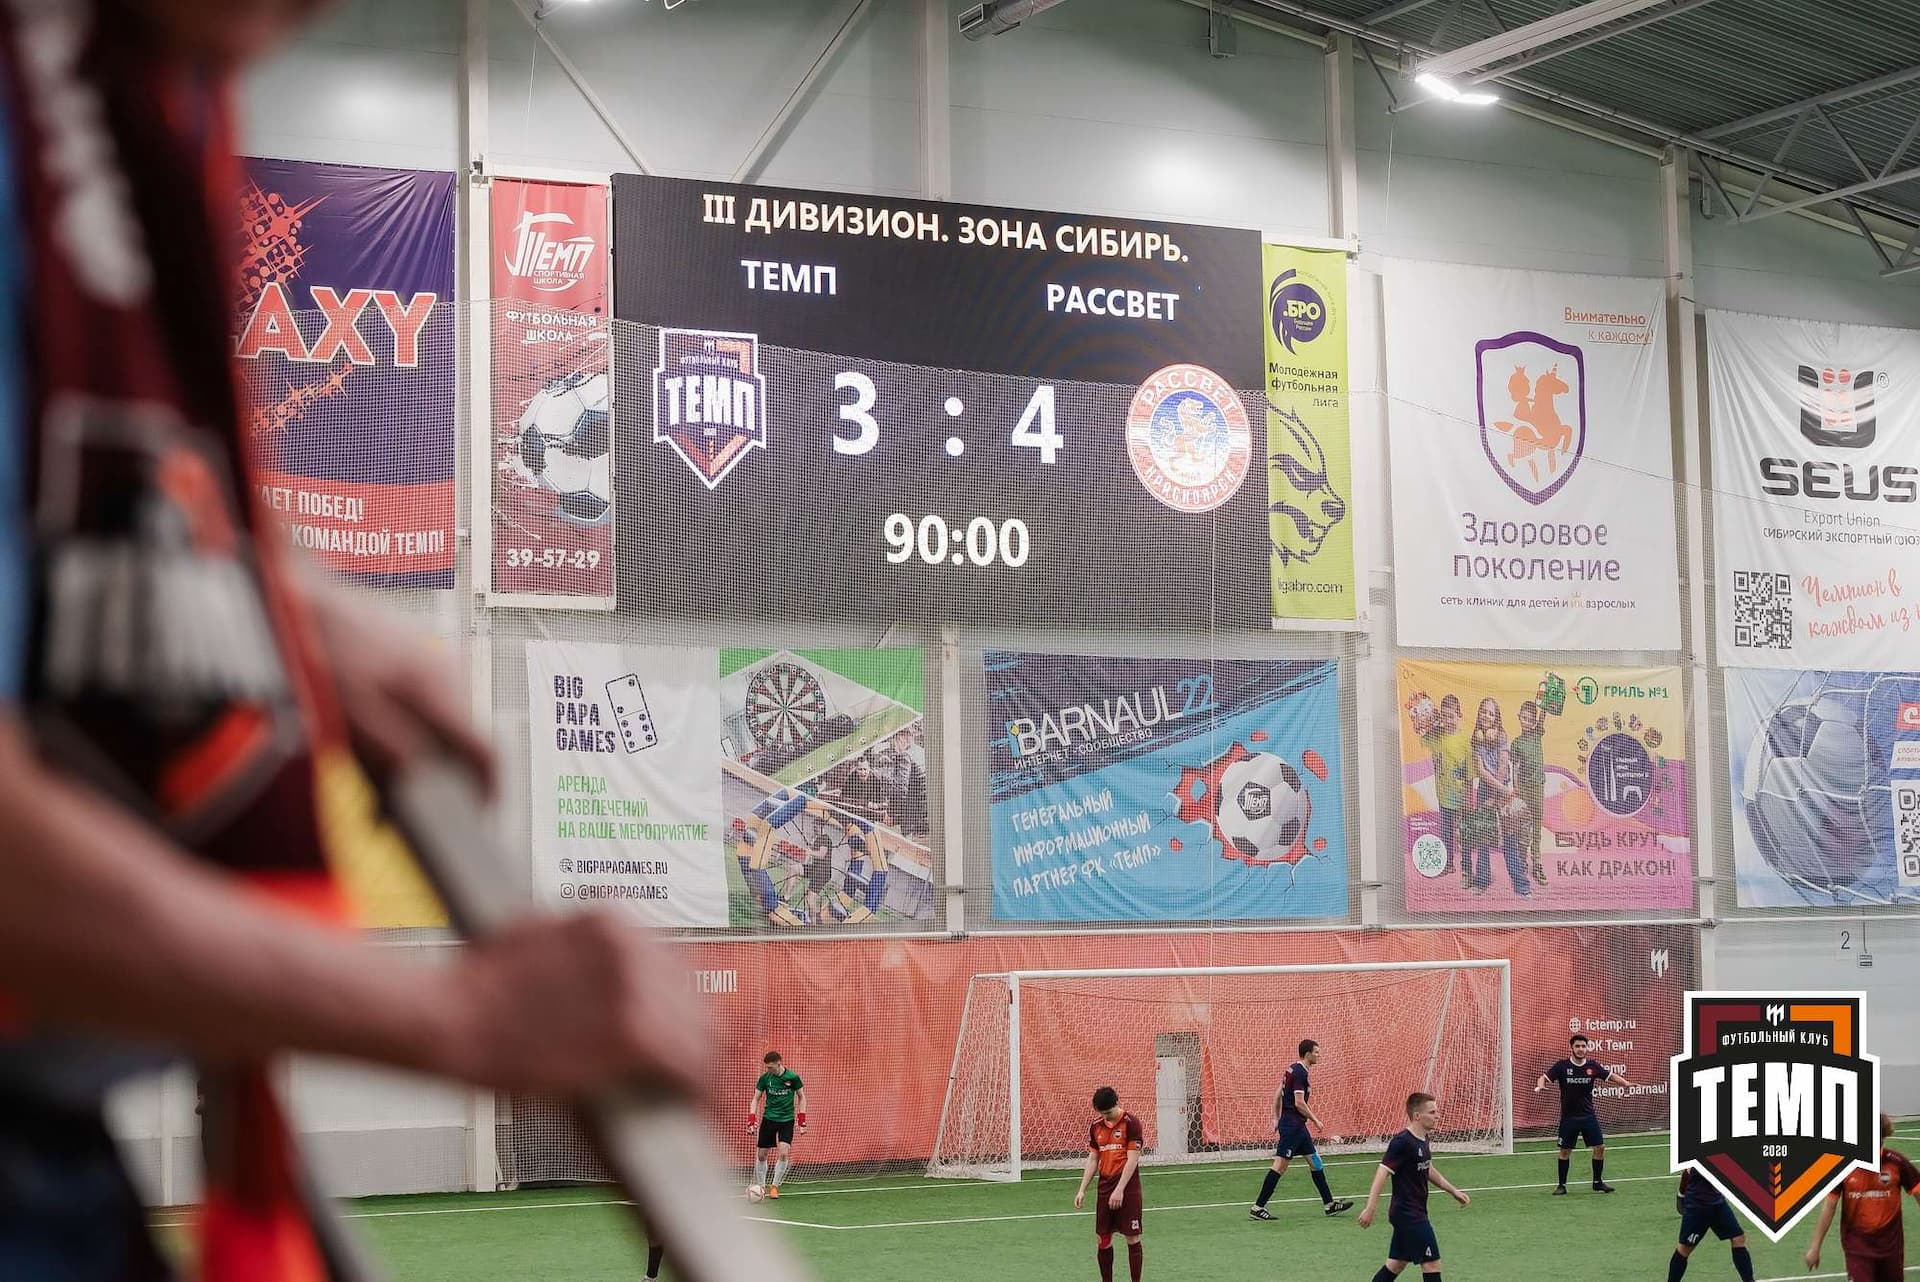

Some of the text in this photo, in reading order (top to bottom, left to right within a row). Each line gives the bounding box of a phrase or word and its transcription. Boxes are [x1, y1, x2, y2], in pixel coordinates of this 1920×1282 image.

[745, 199, 949, 242] ДИВИЗИОН.
[958, 217, 1047, 251] ЗОНА
[1055, 225, 1189, 264] СИБИРЬ.
[533, 270, 585, 280] СПОРТИВНАЯ
[741, 259, 838, 295] ТЕМП
[1046, 283, 1181, 322] РАССВЕТ
[231, 281, 438, 368] AXY
[505, 311, 598, 327] ФУТБОЛЬНАЯ
[1564, 306, 1647, 325] Внимательно
[526, 328, 574, 342] ШКОЛА
[1268, 362, 1339, 379] Молодёжная
[1141, 370, 1239, 411] РАССВЕТ
[1271, 377, 1339, 394] футбольная
[664, 374, 756, 432] ТЕМП
[1312, 398, 1339, 409] лига
[832, 371, 1065, 465] 3 : 4
[1759, 456, 1919, 503] SEUS
[297, 491, 365, 522] ПОБЕД!
[1804, 510, 1881, 528] Export Union
[291, 525, 391, 557] КОМАНДОЙ
[395, 529, 445, 555] ТЕМП!
[884, 512, 1031, 568] 90:00
[1462, 512, 1608, 549] Здоровое
[1763, 527, 1823, 542] СИБИРСКИЙ
[1825, 532, 1893, 545] ЭКСПОРТНЫЙ
[506, 548, 601, 569] 39-57-29
[1453, 554, 1622, 582] поколение
[1801, 575, 1887, 608] Чемпион
[1440, 595, 1463, 606] сеть
[1466, 596, 1504, 607] клиник
[1506, 599, 1526, 609] для
[1528, 596, 1559, 608] детей
[1562, 600, 1569, 608] и
[1585, 600, 1636, 611] взрослых
[1807, 605, 1887, 639] каждом
[1890, 607, 1913, 632] из
[553, 675, 583, 699] BIG
[1603, 686, 1645, 699] ГРИЛЬ
[1648, 687, 1670, 699] №1
[556, 702, 600, 726] PAPA
[556, 728, 616, 753] GAMES
[1014, 747, 1070, 770] ИНТЕРНЕТ
[1078, 727, 1154, 755] СООБЩЕСТВО
[558, 775, 608, 796] АРЕНДА
[558, 797, 649, 818] РАЗВЛЕЧЕНИЙ
[1012, 787, 1114, 833] ГЕНЕРАЛЬНЫЙ
[558, 821, 709, 841] НА ВАШЕ МЕРОПРИЯТИЕ
[1012, 810, 1151, 867] ИНФОРМАЦИОННЫЙ
[1555, 831, 1665, 851] БУДЬ КРУТ,
[576, 860, 668, 875] BIGPAPAGAMES.RU
[1013, 844, 1161, 898] ПАРТНЕР ФК «ТЕМП»
[1557, 859, 1676, 881] КАК ДРАКОН!
[577, 884, 669, 900] @BIGPAPAGAMES
[1841, 931, 1850, 949] 2
[695, 969, 738, 993] ТЕМП!
[1586, 1018, 1637, 1033] fctemp.ru
[1586, 1039, 1634, 1052] ФК Темп
[1286, 1149, 1292, 1158] 3
[1425, 1246, 1433, 1257] 4
